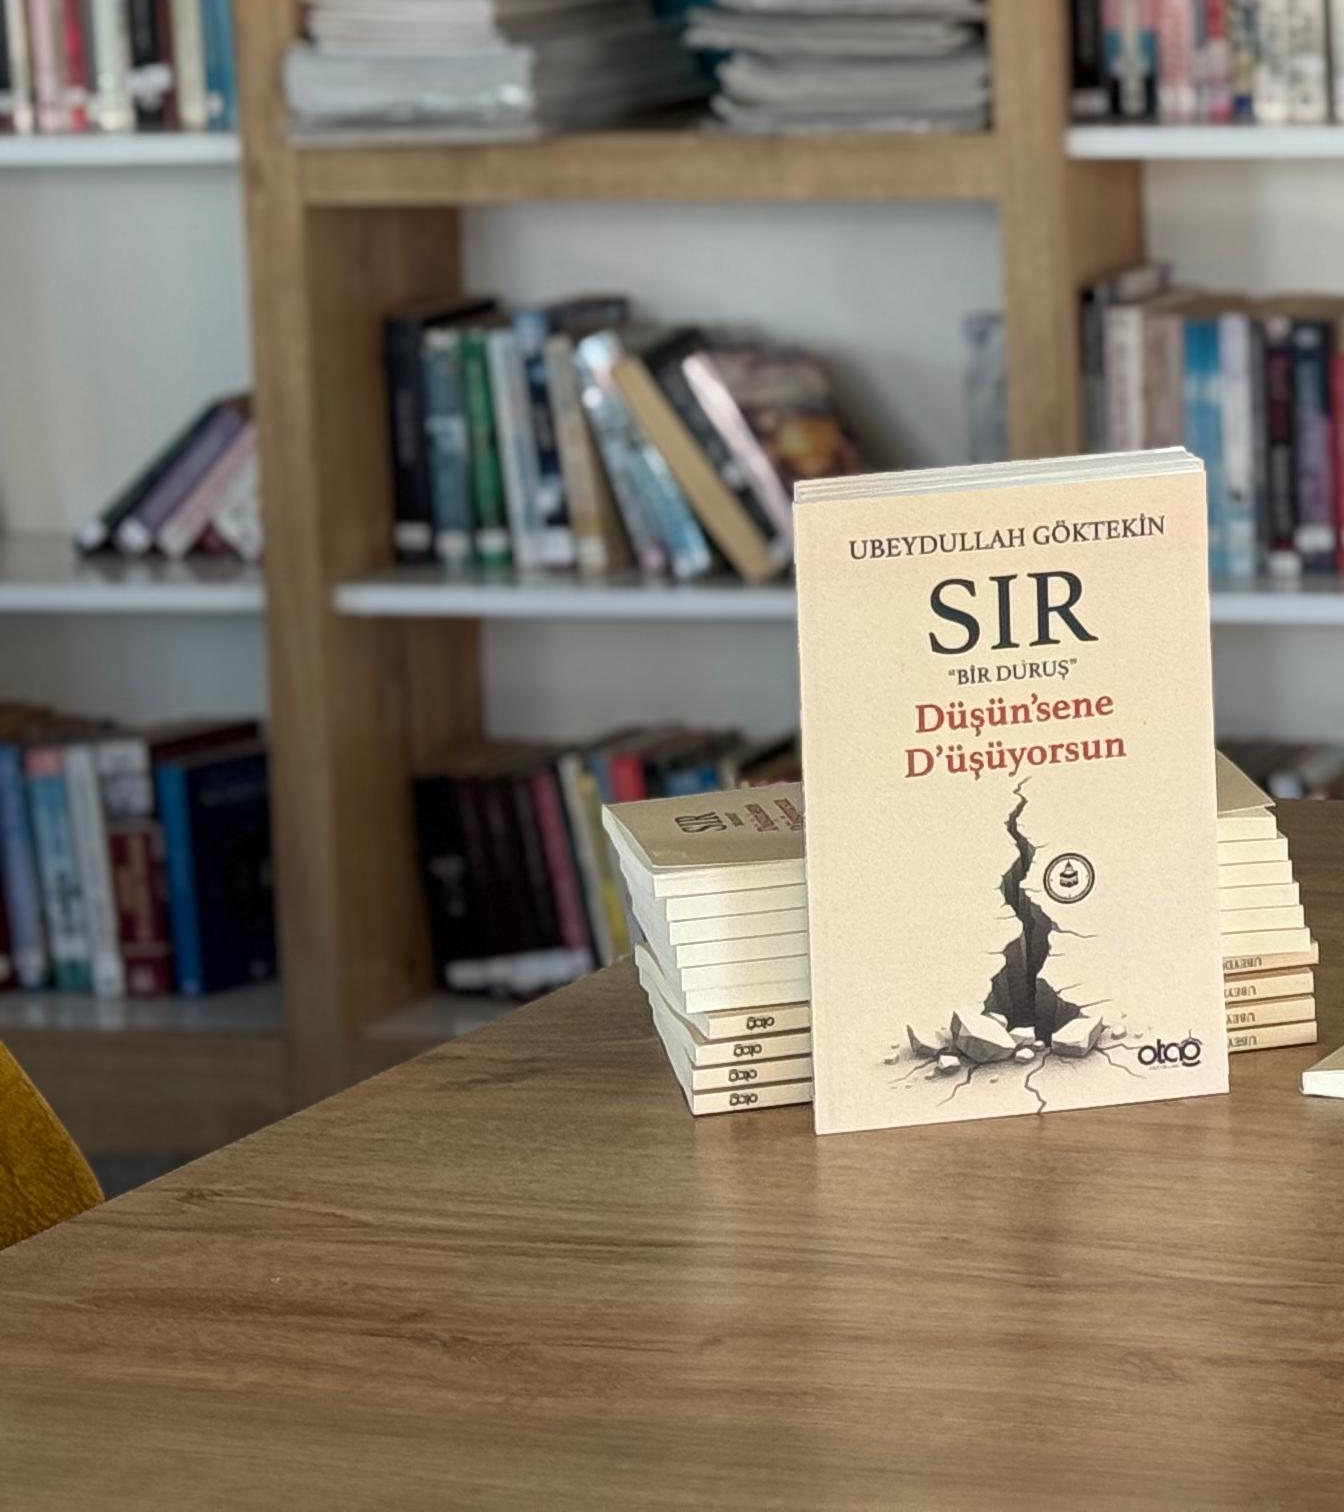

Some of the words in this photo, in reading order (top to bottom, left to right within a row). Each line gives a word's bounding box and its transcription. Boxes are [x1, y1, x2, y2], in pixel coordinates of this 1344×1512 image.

[849, 527, 1026, 561] UBEYDULLAH
[1033, 513, 1167, 546] GÖKTEKİN
[928, 570, 1099, 656] SIR
